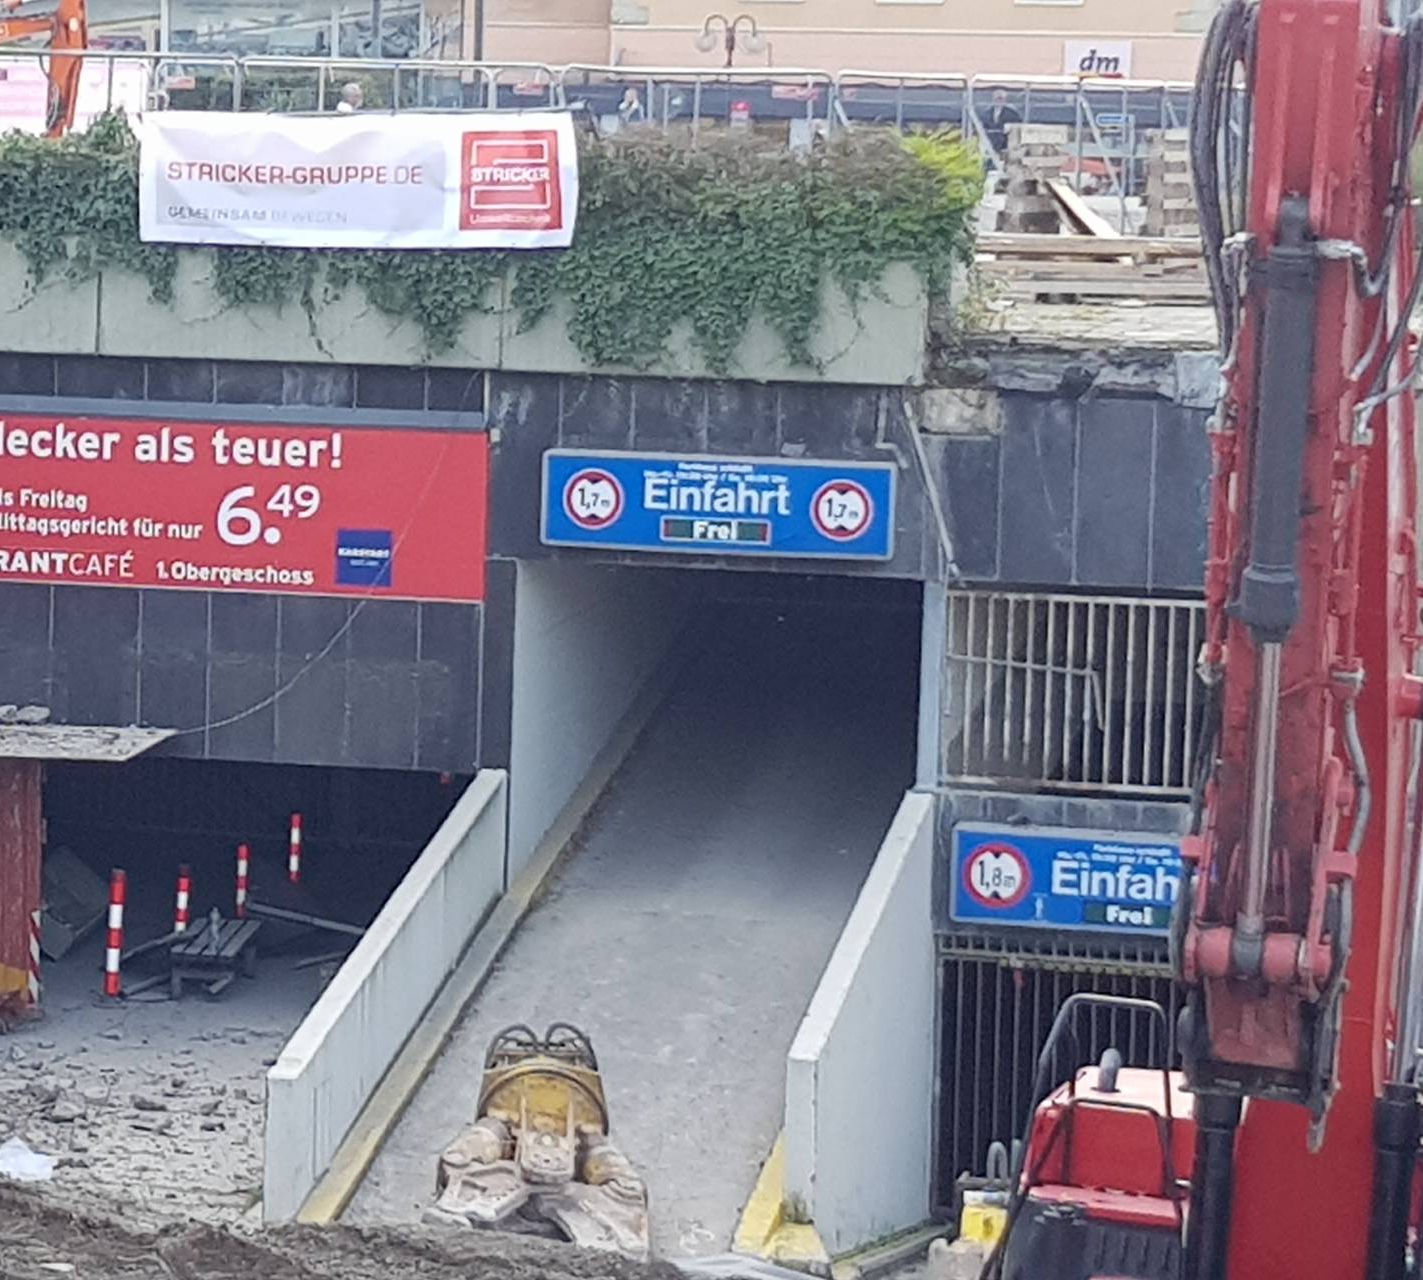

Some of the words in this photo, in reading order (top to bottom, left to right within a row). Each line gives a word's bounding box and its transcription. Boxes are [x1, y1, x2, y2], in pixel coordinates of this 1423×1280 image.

[1079, 49, 1120, 72] dm
[167, 162, 424, 185] STRICKER-GRUPPE.DE
[471, 167, 550, 182] STRICKER
[134, 427, 195, 463] als
[211, 428, 342, 468] teuer!
[20, 489, 87, 513] Freitag
[643, 477, 791, 516] Einfahrt
[133, 517, 163, 537] für
[167, 524, 203, 539] nur
[692, 519, 739, 541] Frei
[1051, 859, 1180, 901] Einfah
[1105, 904, 1155, 926] Frei
